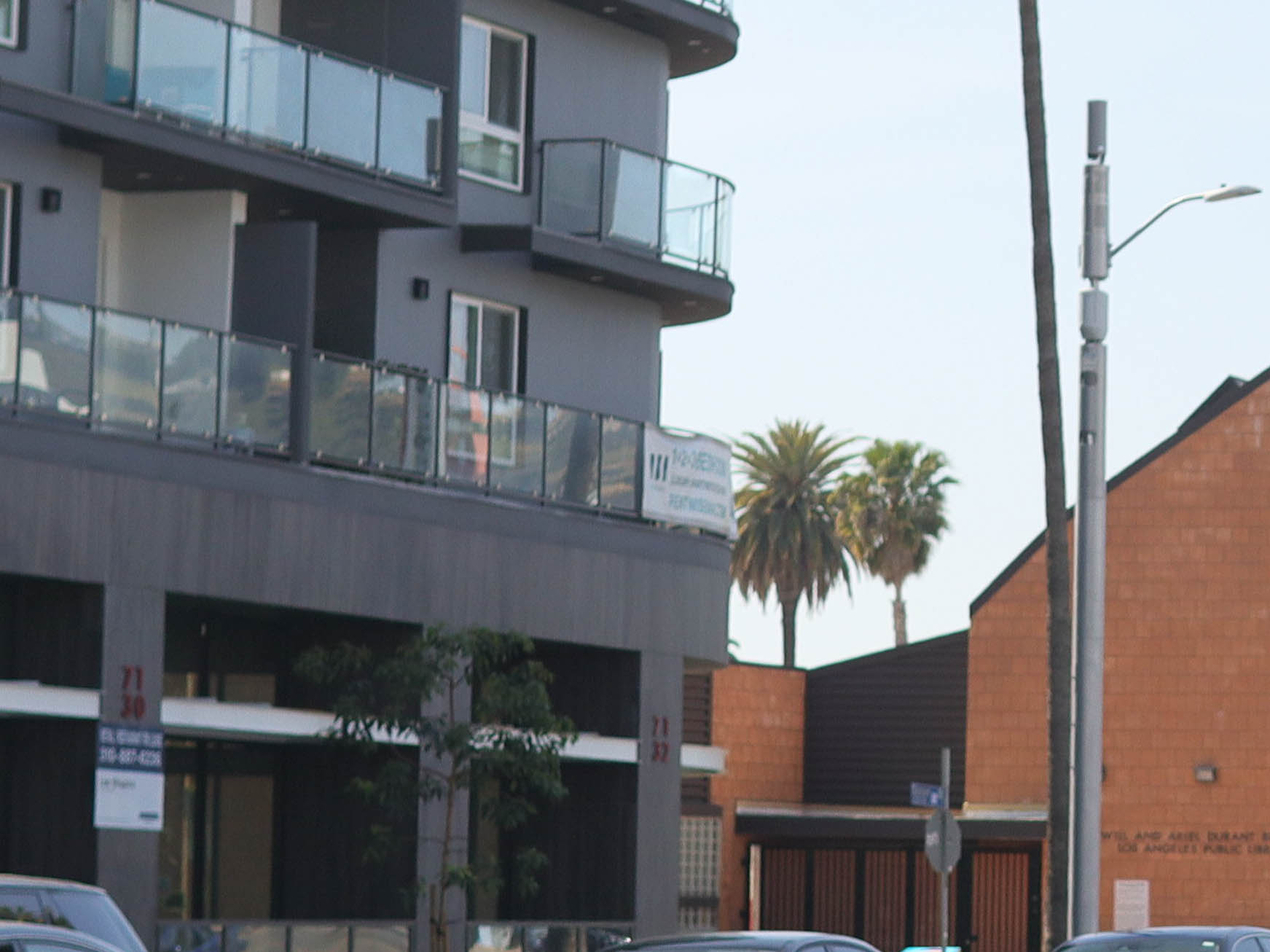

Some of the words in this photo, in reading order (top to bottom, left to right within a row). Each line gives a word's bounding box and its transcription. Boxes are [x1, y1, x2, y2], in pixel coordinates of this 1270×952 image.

[1117, 843, 1137, 853] LOS
[1144, 843, 1198, 854] ANGELES
[1203, 843, 1240, 855] PUBLIC
